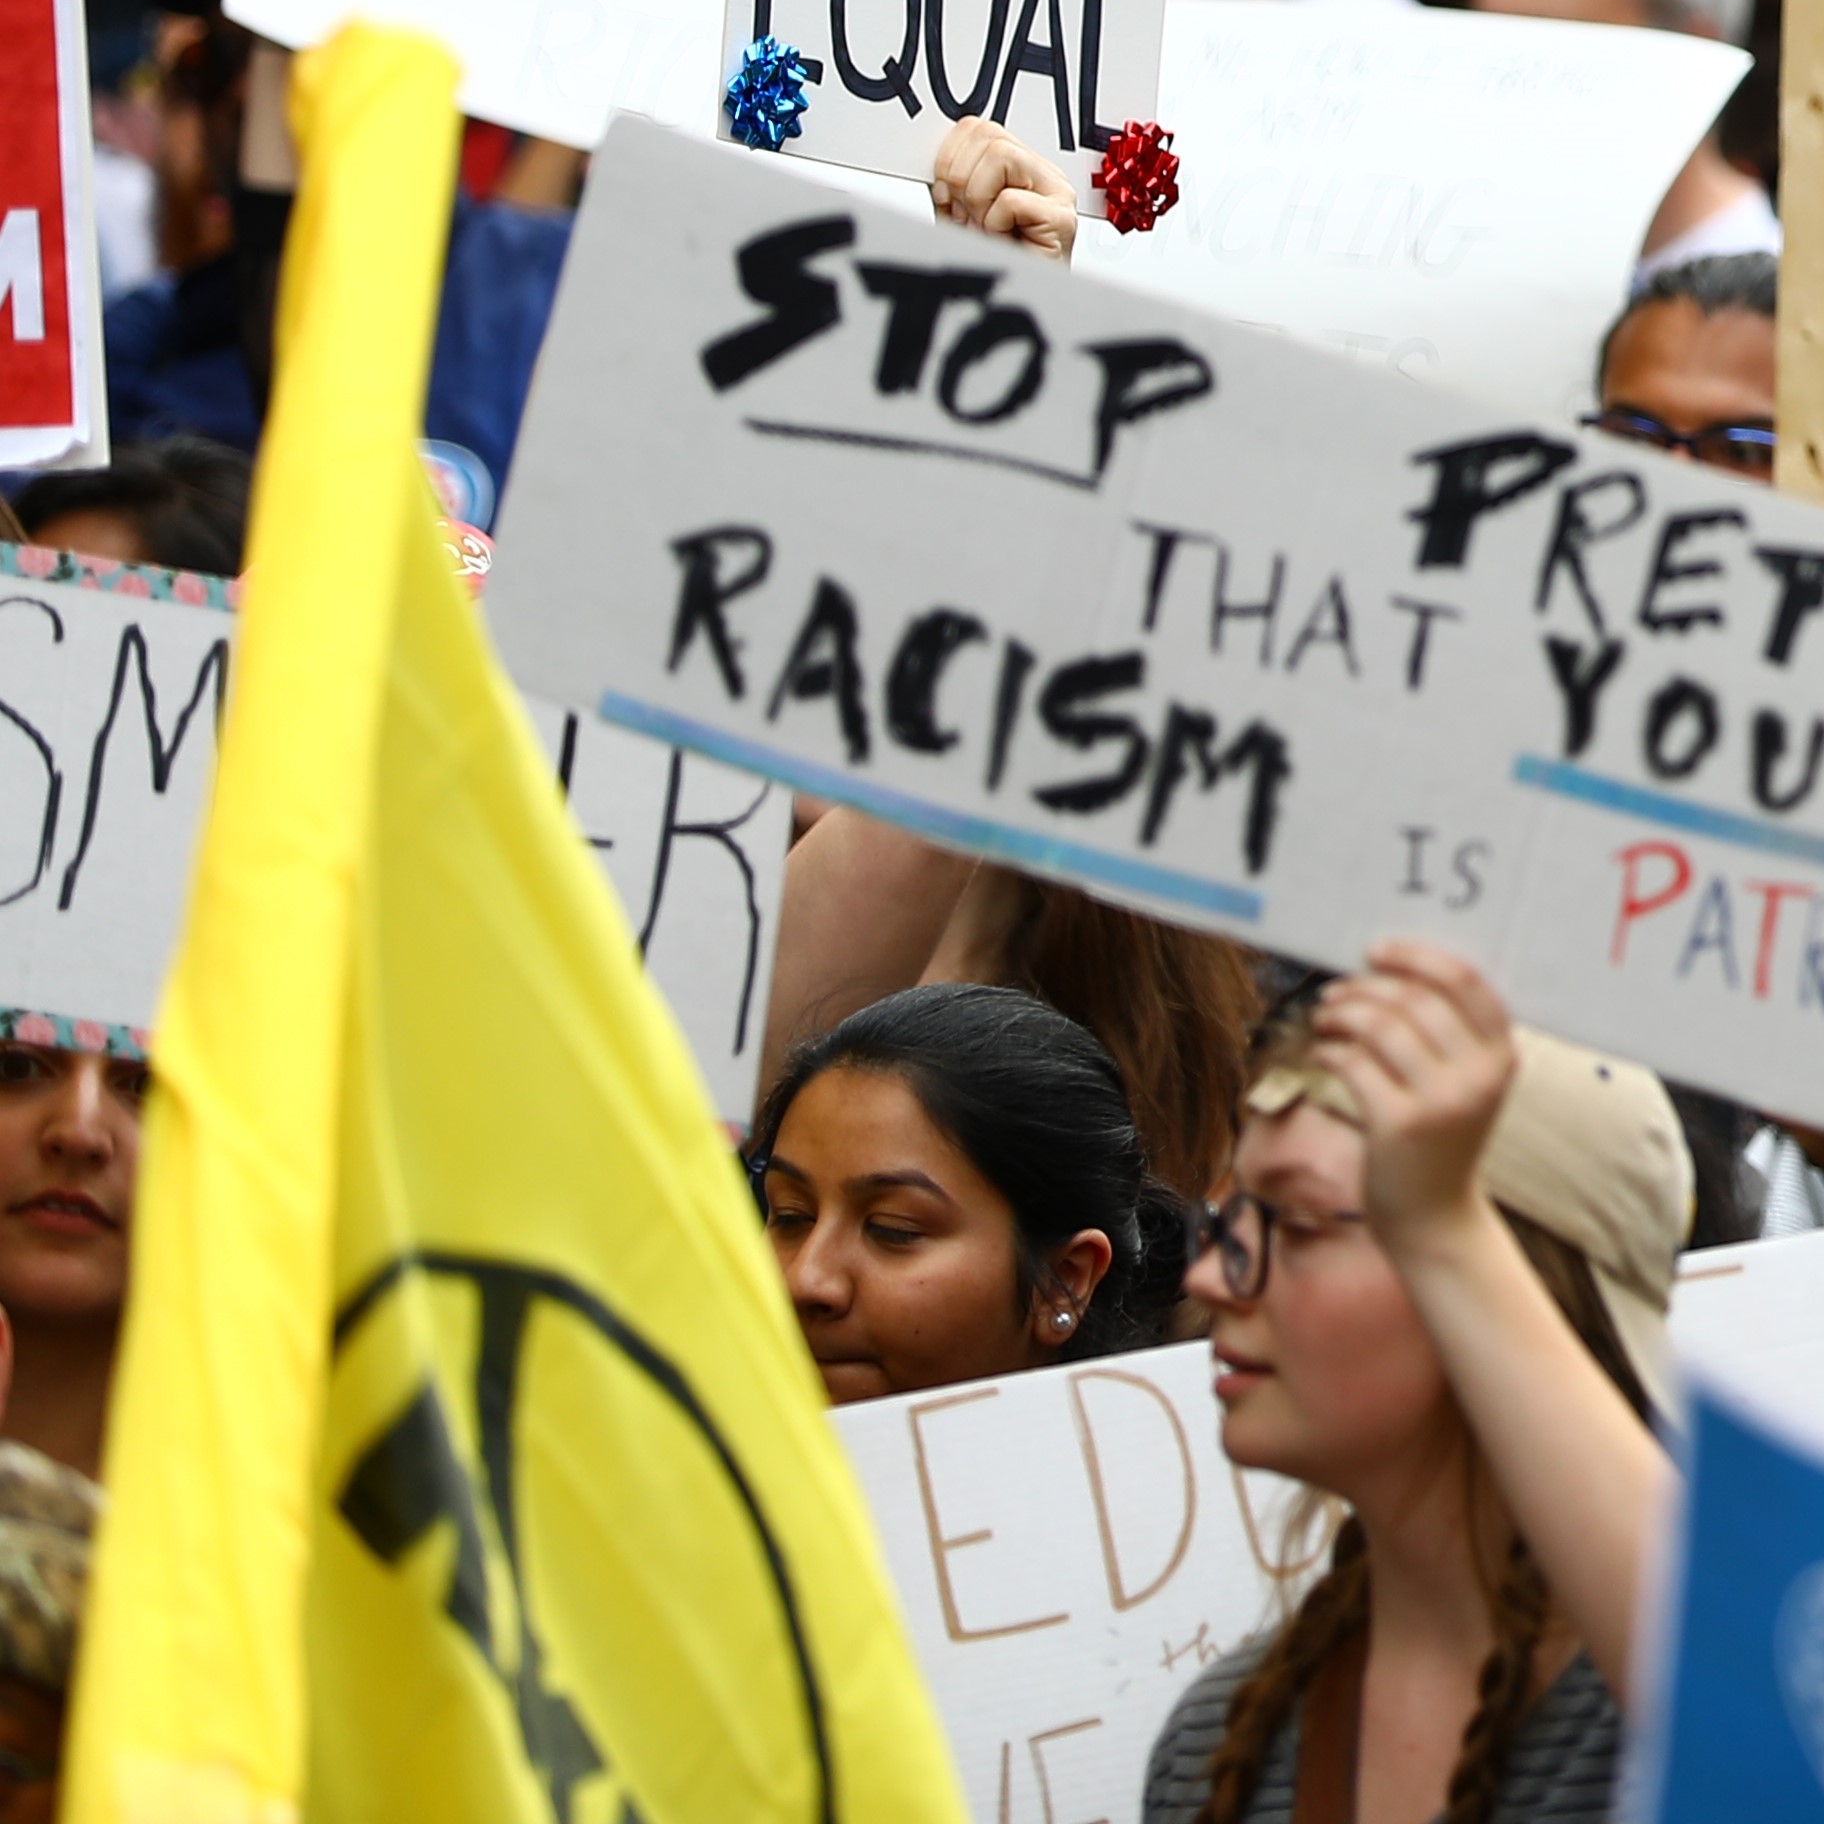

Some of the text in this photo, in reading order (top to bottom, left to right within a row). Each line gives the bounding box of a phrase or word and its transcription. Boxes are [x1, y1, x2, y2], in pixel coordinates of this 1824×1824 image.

[700, 214, 1215, 480] STOP
[667, 525, 1293, 876] RACISM
[1395, 825, 1490, 911] IS
[1130, 519, 1464, 691] THAT
